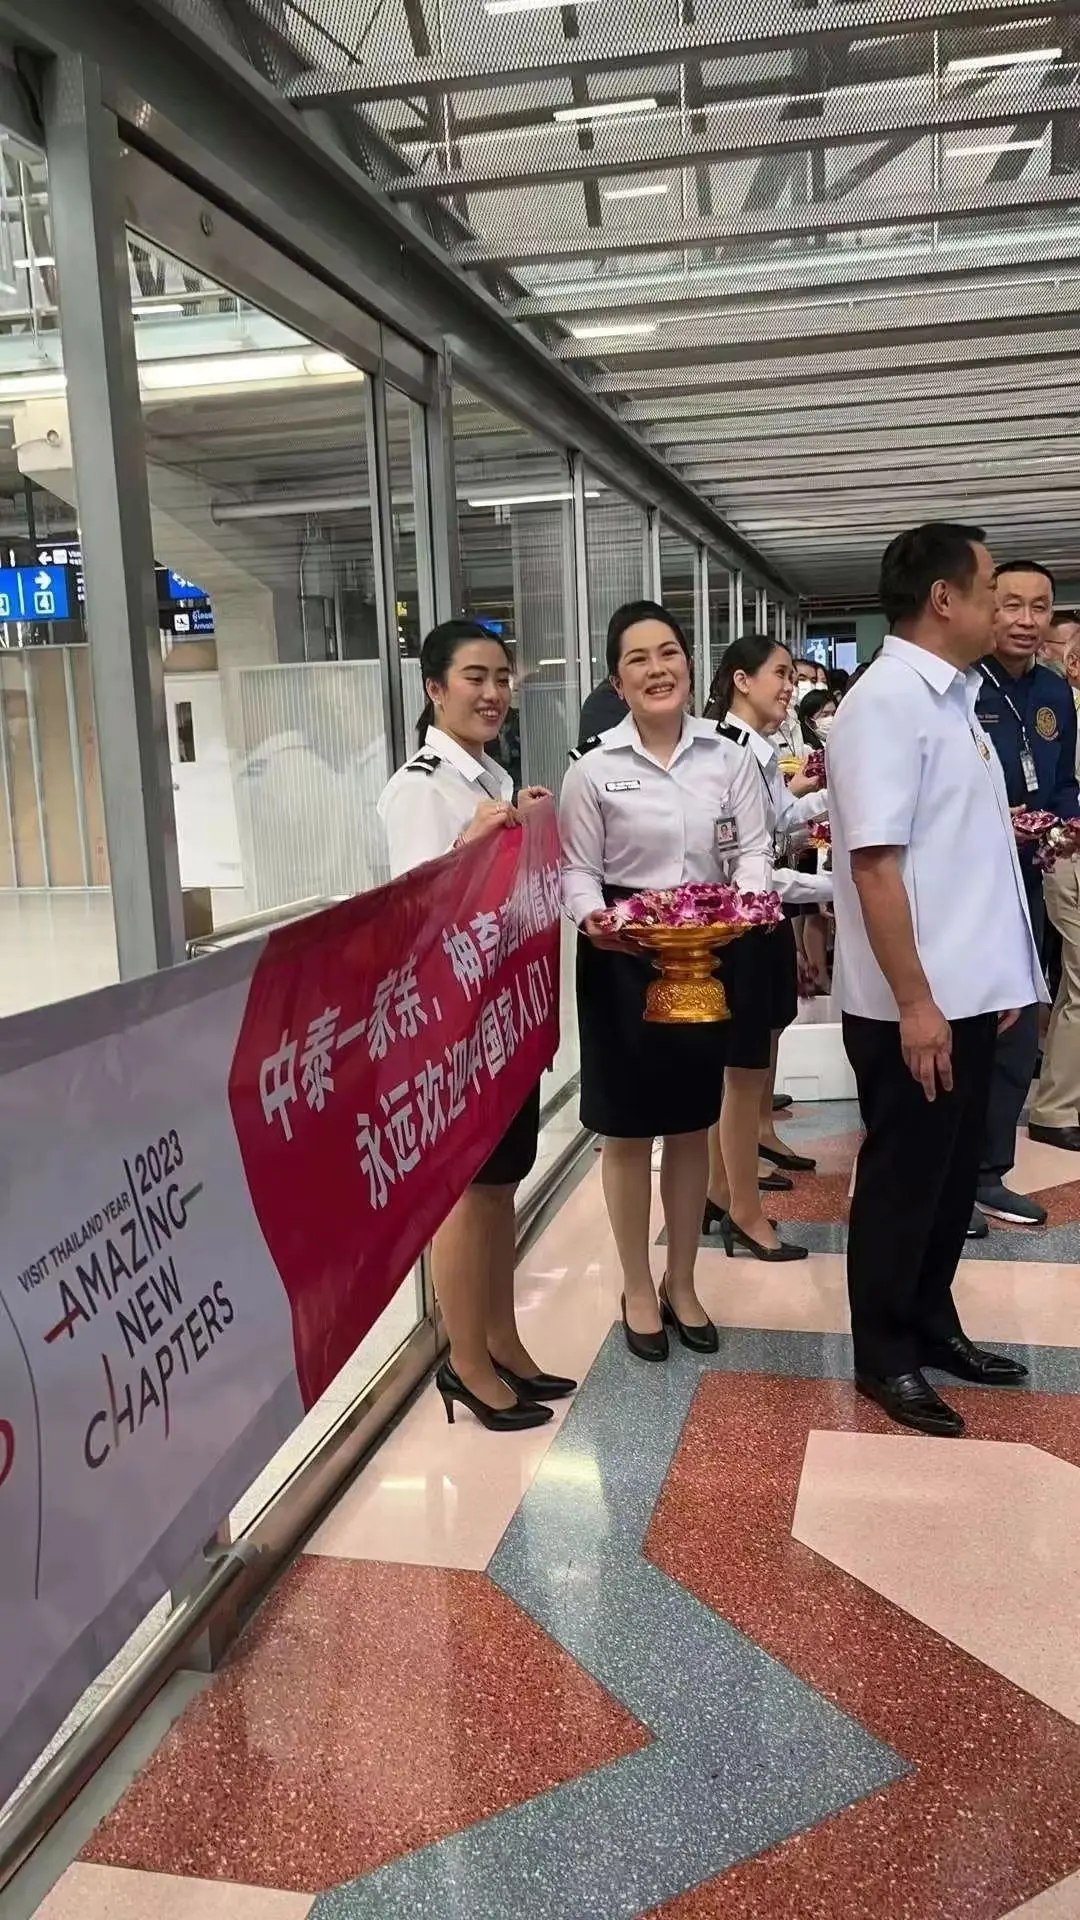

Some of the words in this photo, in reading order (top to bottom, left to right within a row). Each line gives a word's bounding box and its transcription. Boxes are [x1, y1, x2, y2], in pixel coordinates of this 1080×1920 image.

[17, 1255, 50, 1293] VISIT
[48, 1213, 103, 1268] THAILAND
[102, 1191, 131, 1225] YEAR
[135, 1128, 184, 1196] 2023
[44, 1159, 203, 1343] AMAZING
[84, 1280, 234, 1469] CHAPTERS
[115, 1256, 183, 1359] NEW
